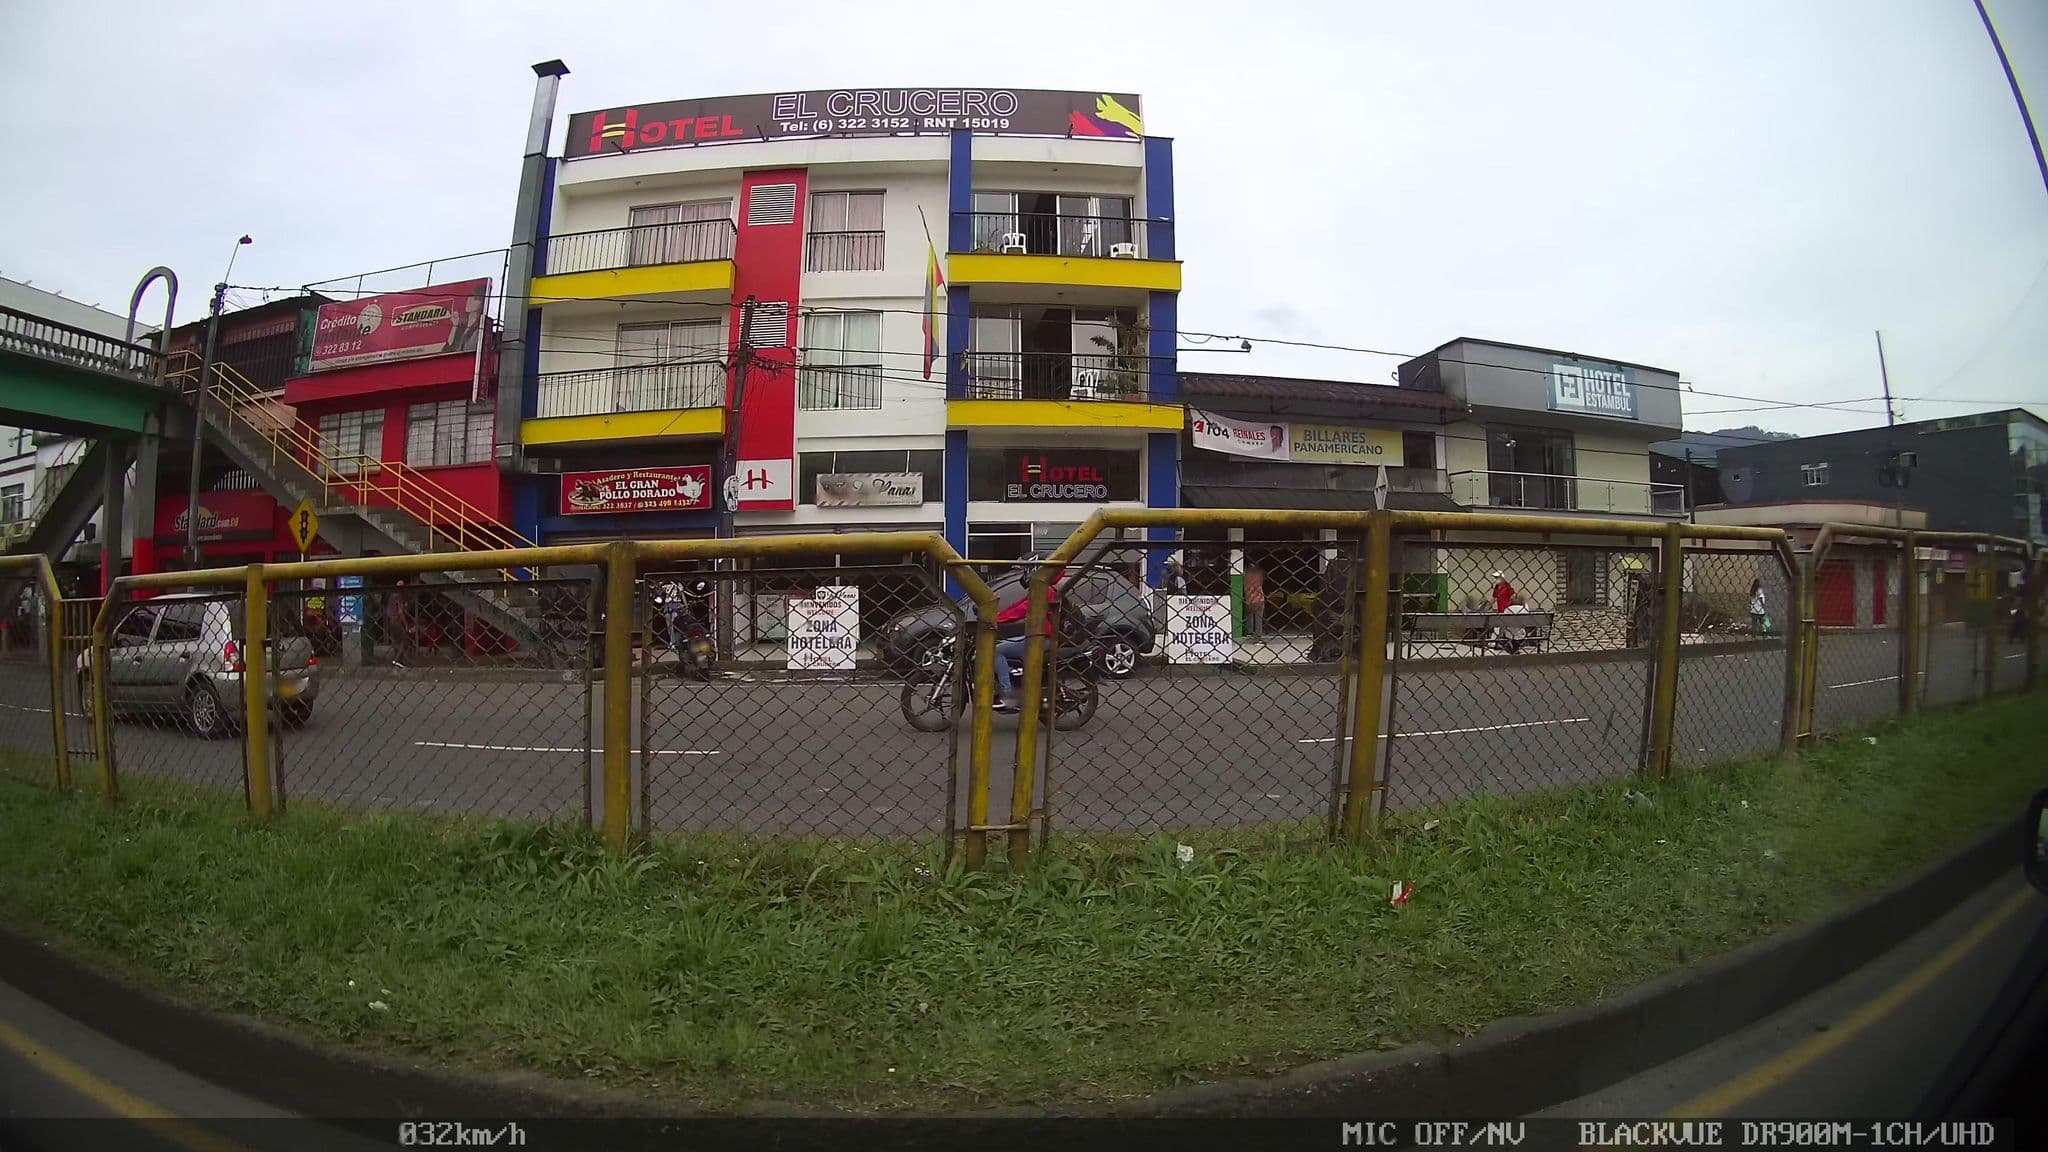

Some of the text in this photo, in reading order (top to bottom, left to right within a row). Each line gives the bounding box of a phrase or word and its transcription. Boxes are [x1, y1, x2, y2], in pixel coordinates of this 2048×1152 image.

[772, 90, 1019, 121] EL CRUCERO
[588, 107, 744, 153] HOTEL
[780, 117, 1010, 133] Tel: (6) 322 3152 RNT 15019
[395, 306, 449, 324] STANDARD
[321, 344, 338, 356] 322
[352, 339, 362, 351] 12
[1583, 368, 1632, 398] HOTEL
[1585, 392, 1632, 412] ESTAMBUL
[1303, 429, 1366, 444] BILLARES
[1294, 442, 1384, 456] PANAMERICANO
[1020, 455, 1104, 482] HOTEL
[615, 479, 659, 490] EL GRAN
[1007, 483, 1108, 499] EL CRUCERO
[599, 488, 676, 500] POLLO DORADO
[806, 620, 838, 633] ZONA
[1185, 616, 1215, 628] ZONA
